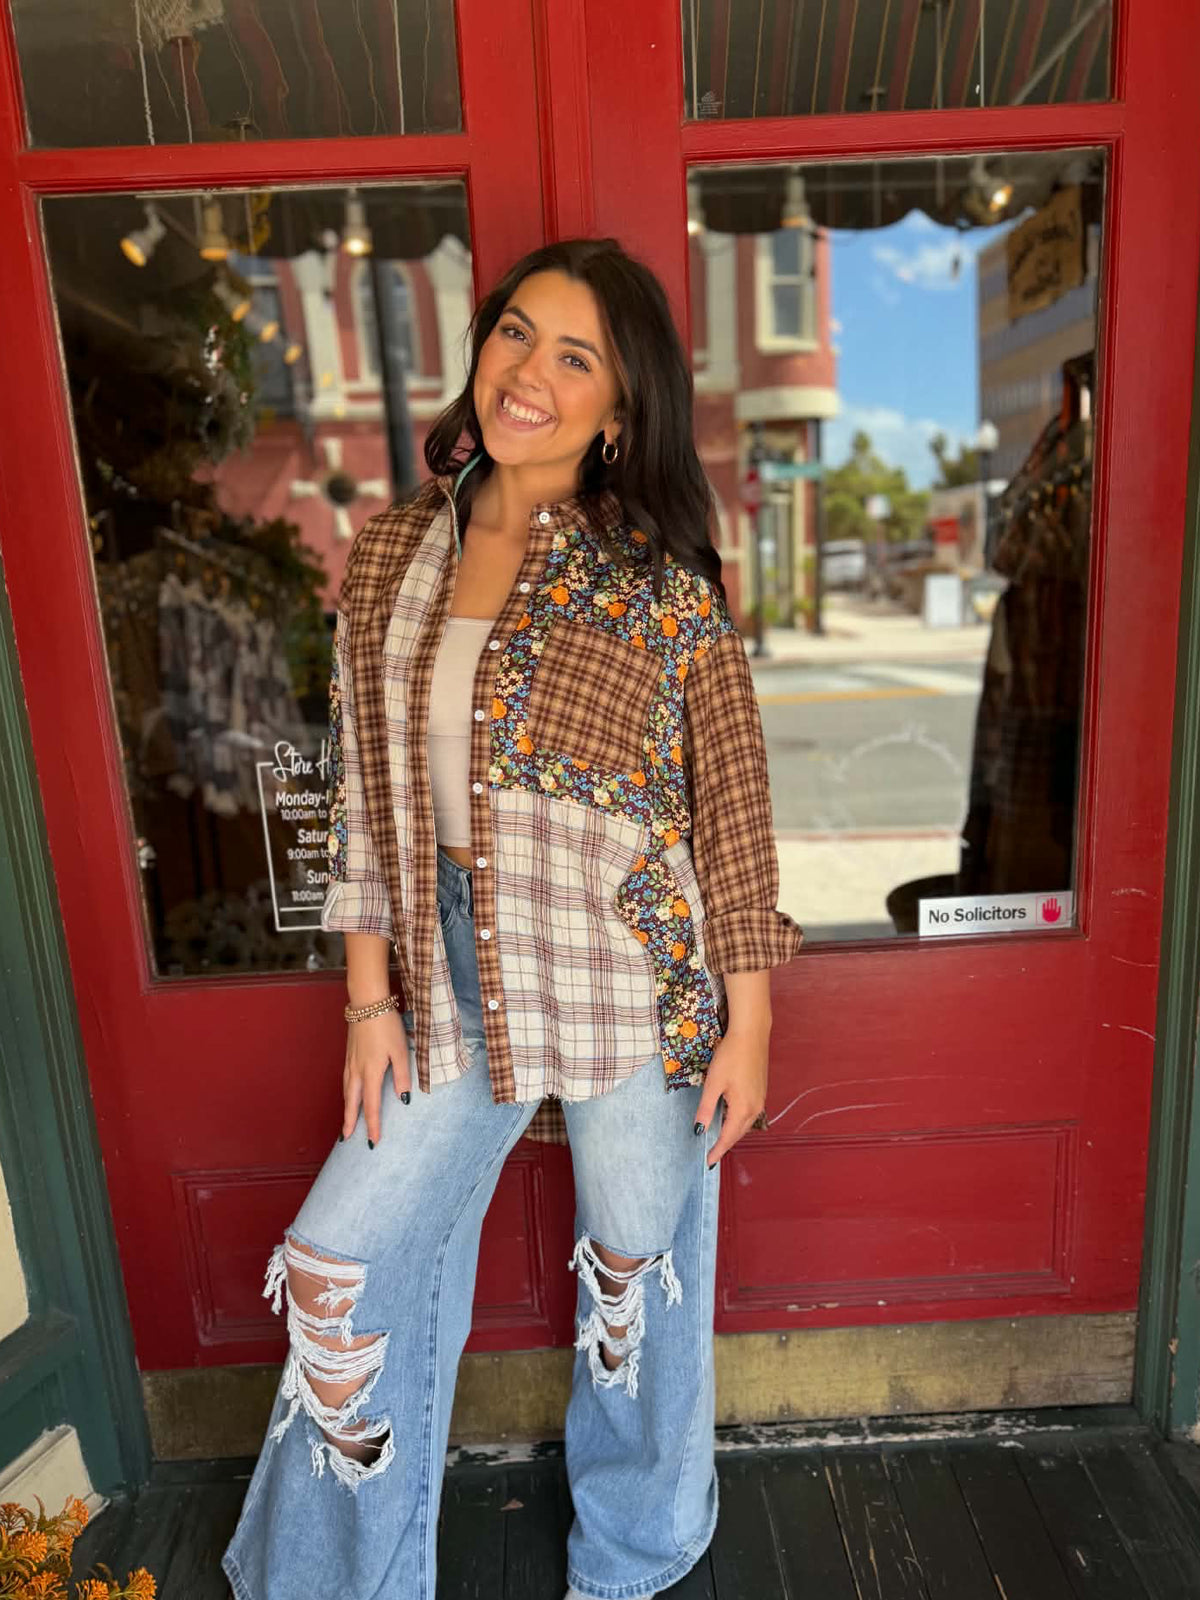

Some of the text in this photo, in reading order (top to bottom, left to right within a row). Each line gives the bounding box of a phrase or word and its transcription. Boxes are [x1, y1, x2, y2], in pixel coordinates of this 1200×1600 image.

[272, 737, 332, 783] Store H
[275, 788, 329, 808] Monday-
[281, 808, 328, 821] 10:00am to
[297, 828, 329, 844] Satur
[287, 848, 320, 860] 9:00am
[291, 890, 324, 903] 11:00am
[929, 905, 1027, 924] No Solicitors
